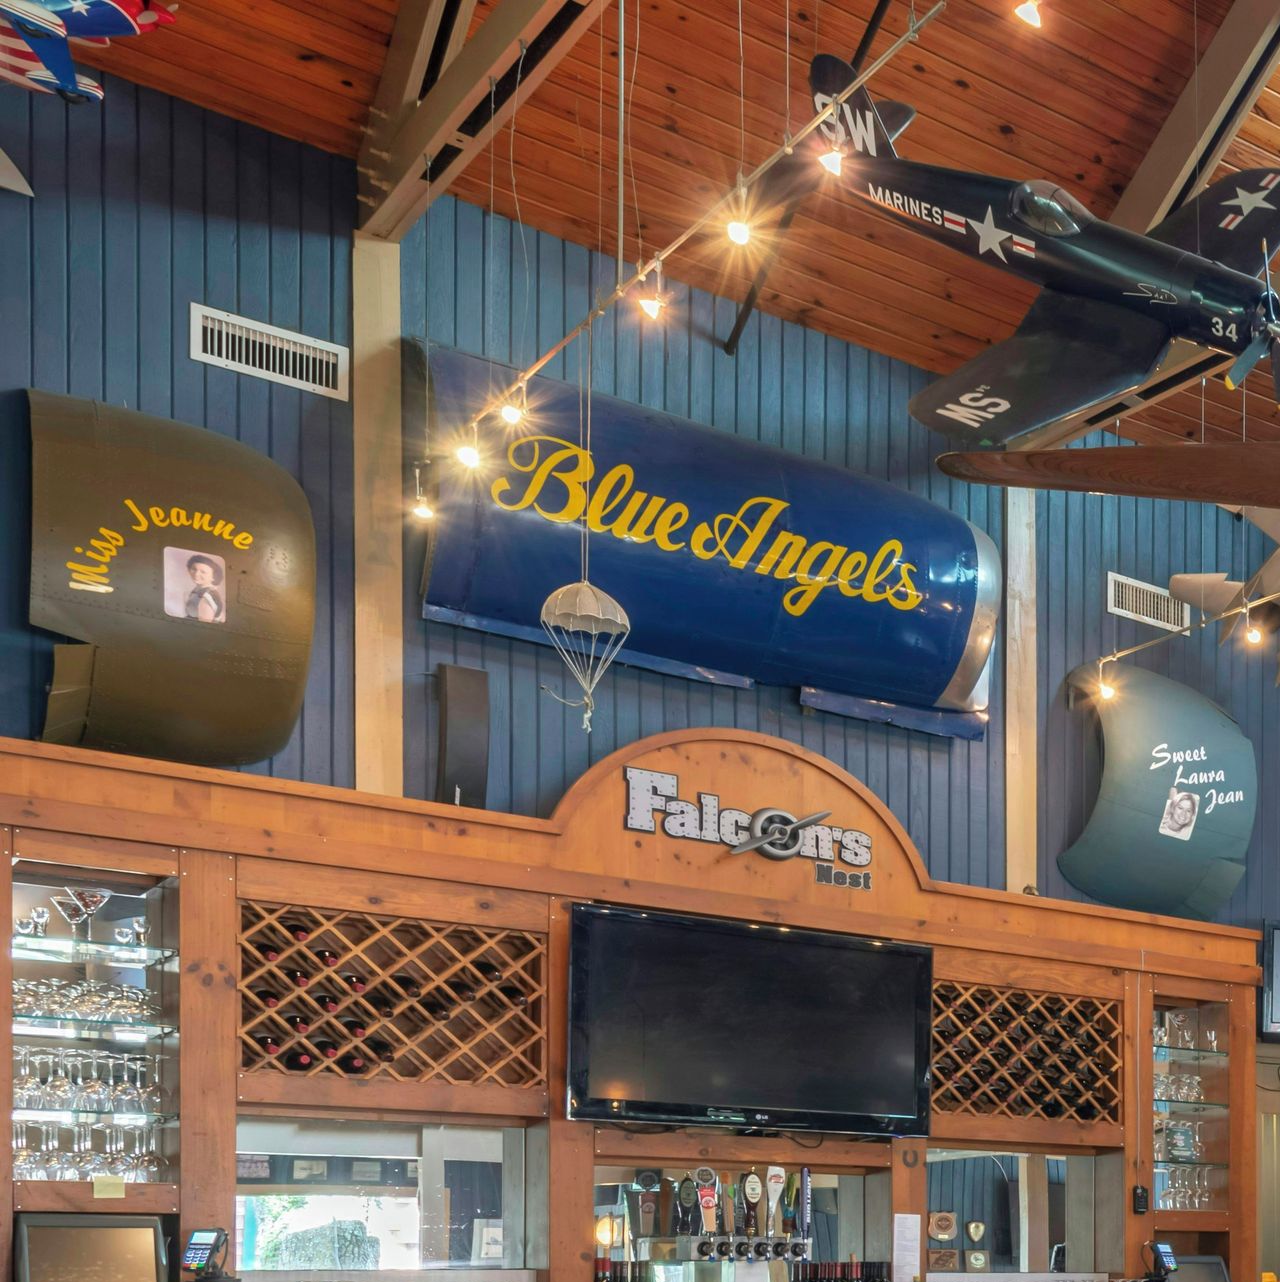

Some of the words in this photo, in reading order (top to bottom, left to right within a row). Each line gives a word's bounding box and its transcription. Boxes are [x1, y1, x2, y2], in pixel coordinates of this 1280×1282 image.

[814, 92, 876, 158] SW
[868, 182, 943, 225] MARINES
[1211, 316, 1238, 342] 34
[490, 435, 689, 552] Blue
[690, 496, 924, 617] Angels
[66, 527, 125, 594] Miss
[124, 498, 254, 550] Jeanne
[1149, 743, 1208, 770] Sweet
[1174, 765, 1225, 787] Laura
[622, 765, 873, 867] Falcon's
[1204, 788, 1244, 815] Jean
[815, 862, 873, 891] Nest
